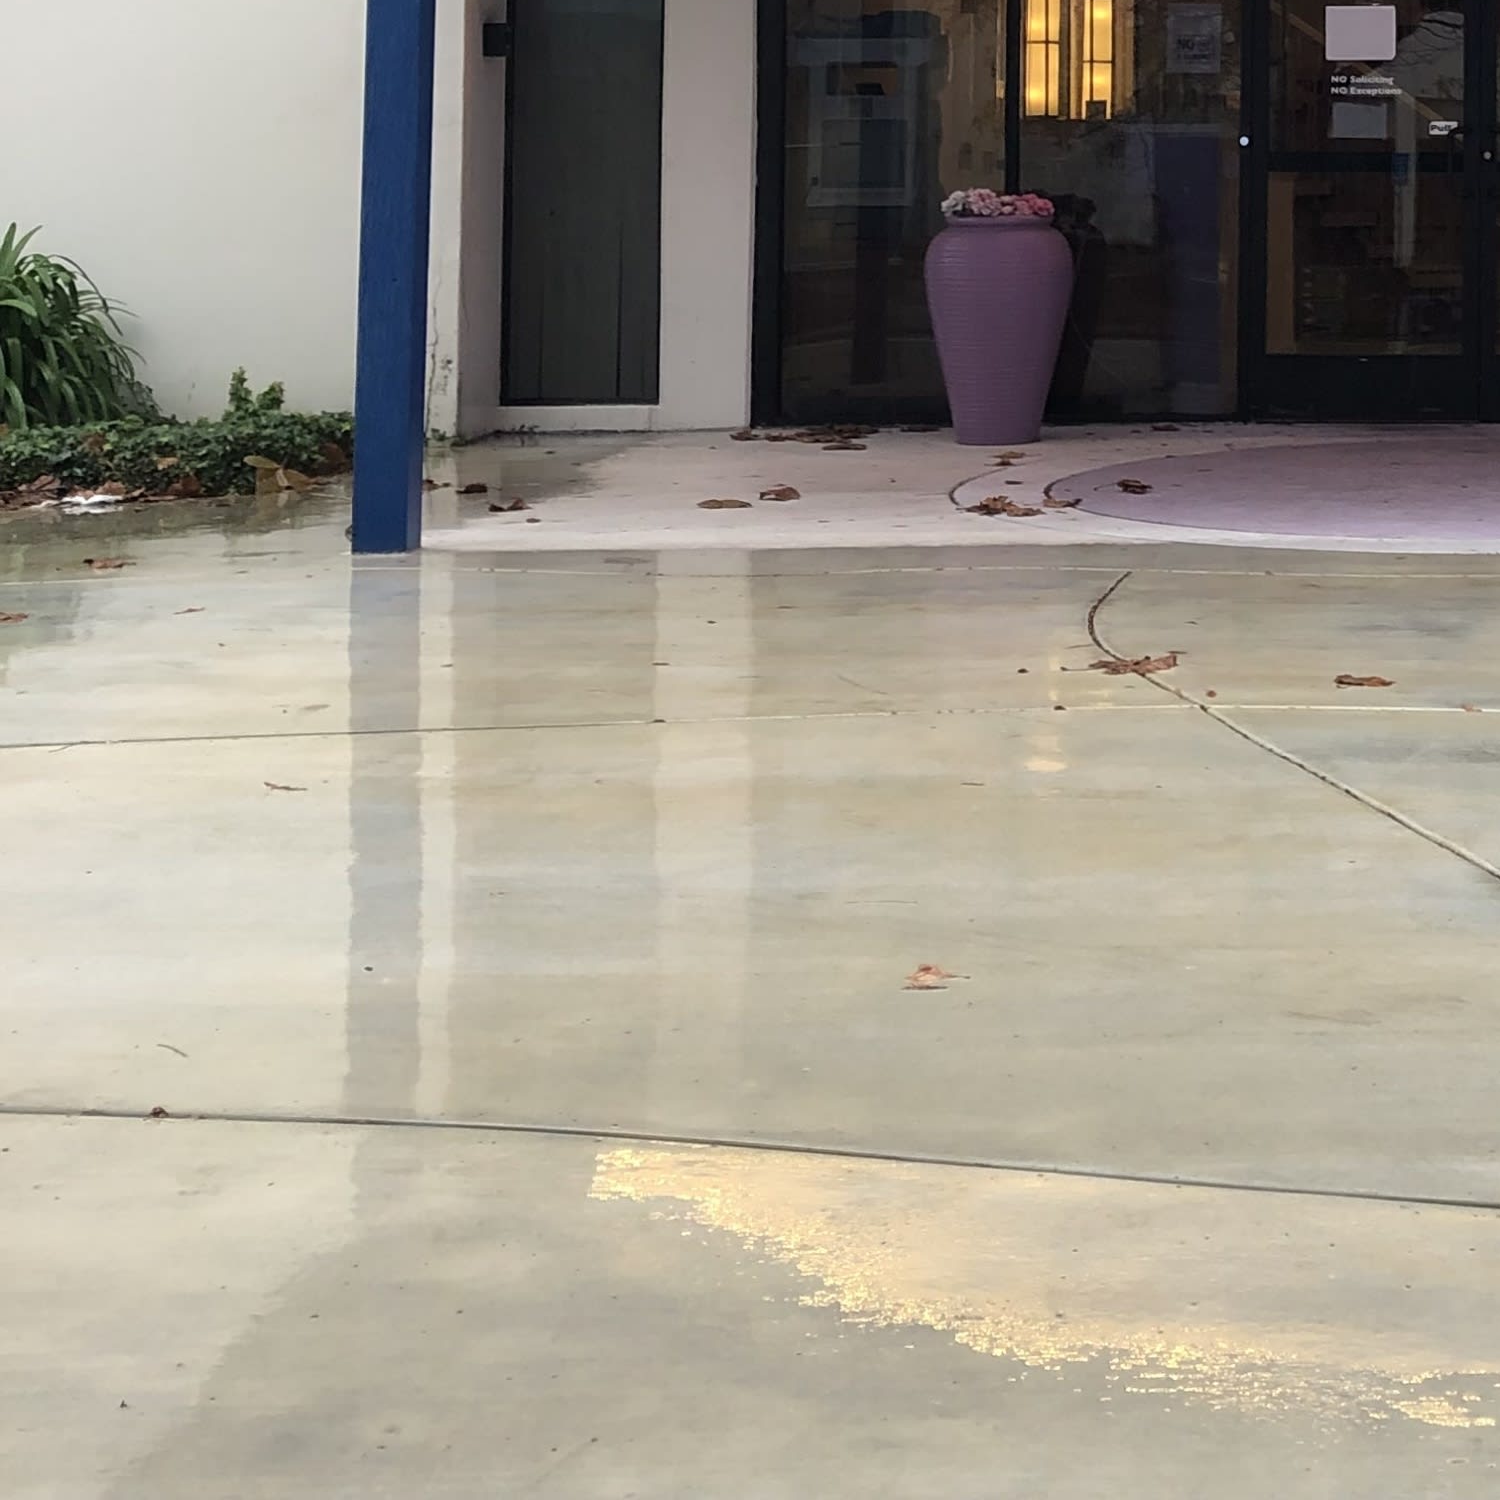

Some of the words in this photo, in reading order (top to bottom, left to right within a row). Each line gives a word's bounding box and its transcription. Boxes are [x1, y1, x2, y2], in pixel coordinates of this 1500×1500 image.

[1330, 75, 1348, 83] NO
[1349, 75, 1394, 85] Soliciting
[1330, 86, 1348, 95] NO
[1349, 86, 1403, 97] Exceptions
